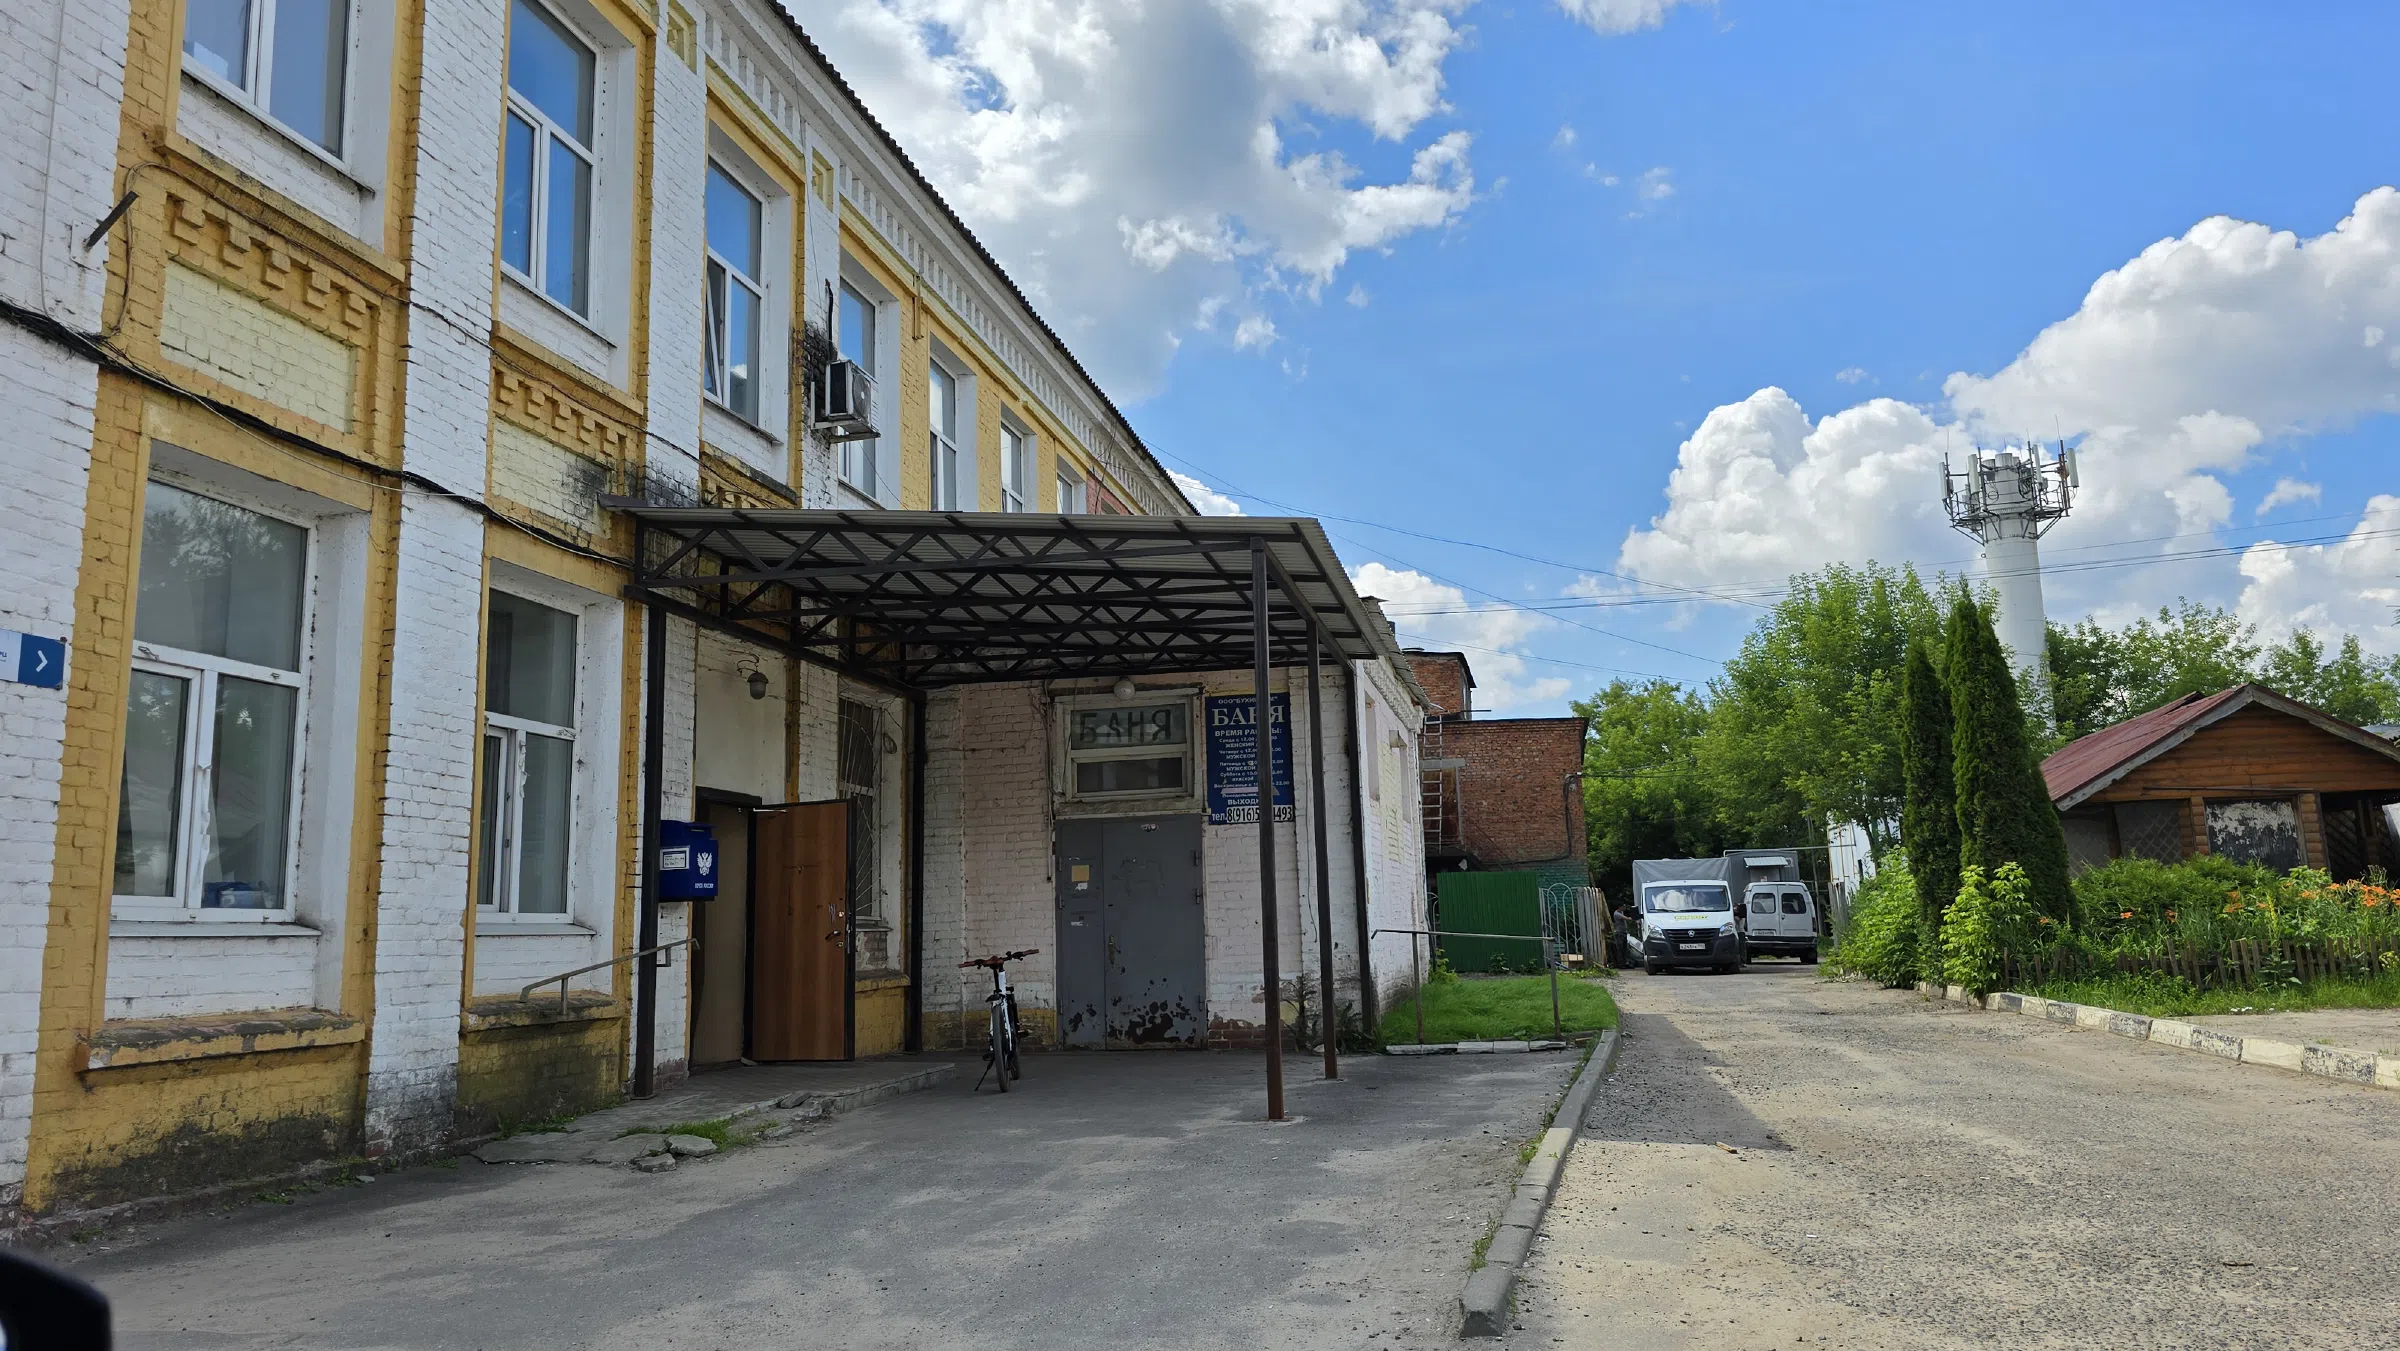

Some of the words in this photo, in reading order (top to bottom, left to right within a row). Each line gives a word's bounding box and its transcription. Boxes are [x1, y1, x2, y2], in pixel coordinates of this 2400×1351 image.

[1080, 709, 1171, 743] БАНЯ
[1214, 729, 1243, 737] ВРЕМЯ
[1227, 798, 1259, 806] ВЫХОД
